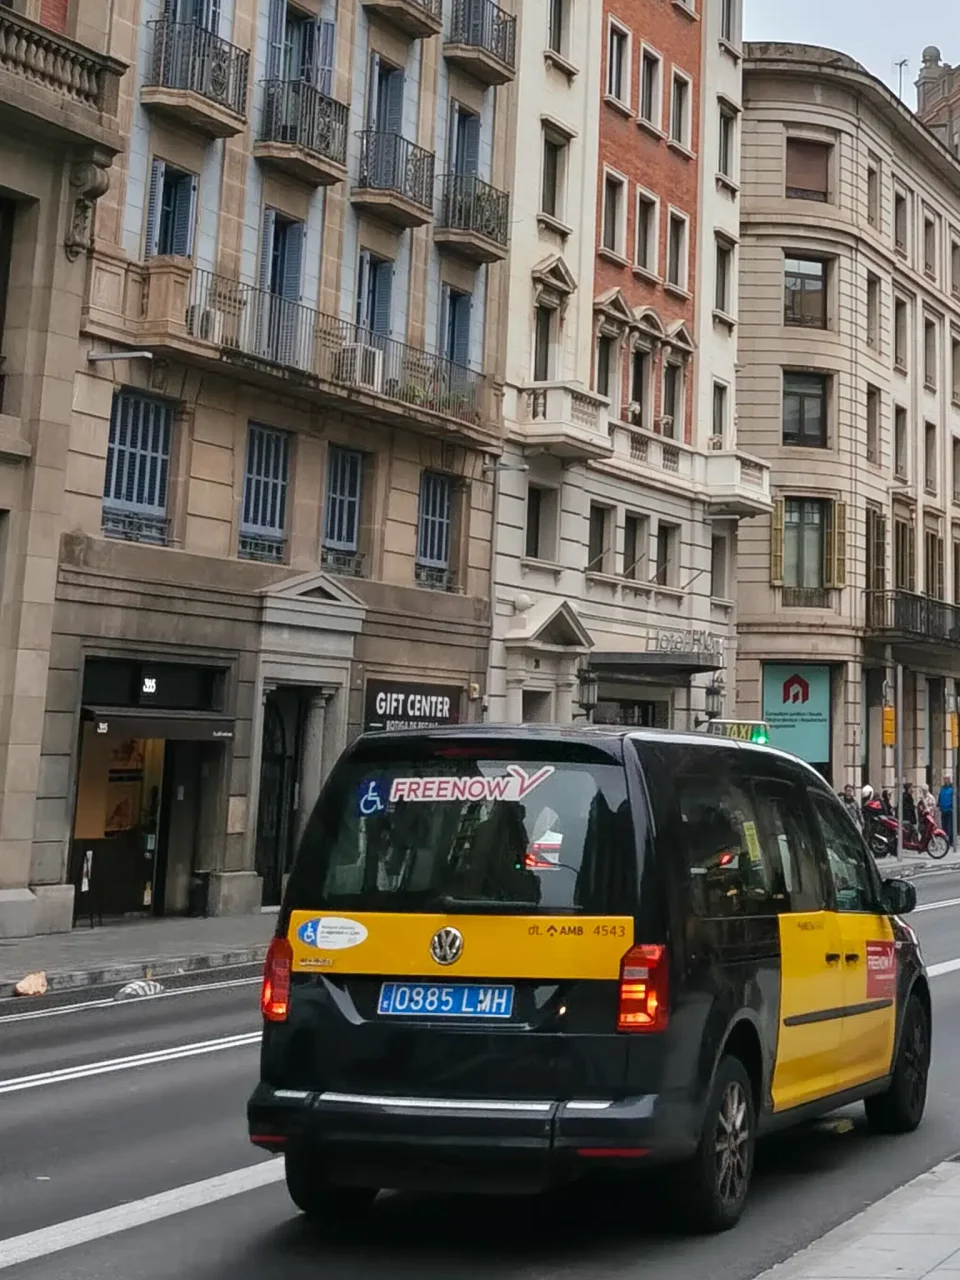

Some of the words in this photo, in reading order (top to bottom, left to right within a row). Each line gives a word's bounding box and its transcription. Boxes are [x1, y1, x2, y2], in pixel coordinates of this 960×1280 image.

[375, 692, 405, 715] GIFT
[407, 694, 451, 717] CENTER
[725, 723, 753, 740] TAXI
[392, 780, 510, 799] FREENOW
[559, 925, 584, 936] AMB
[592, 925, 626, 938] 4543
